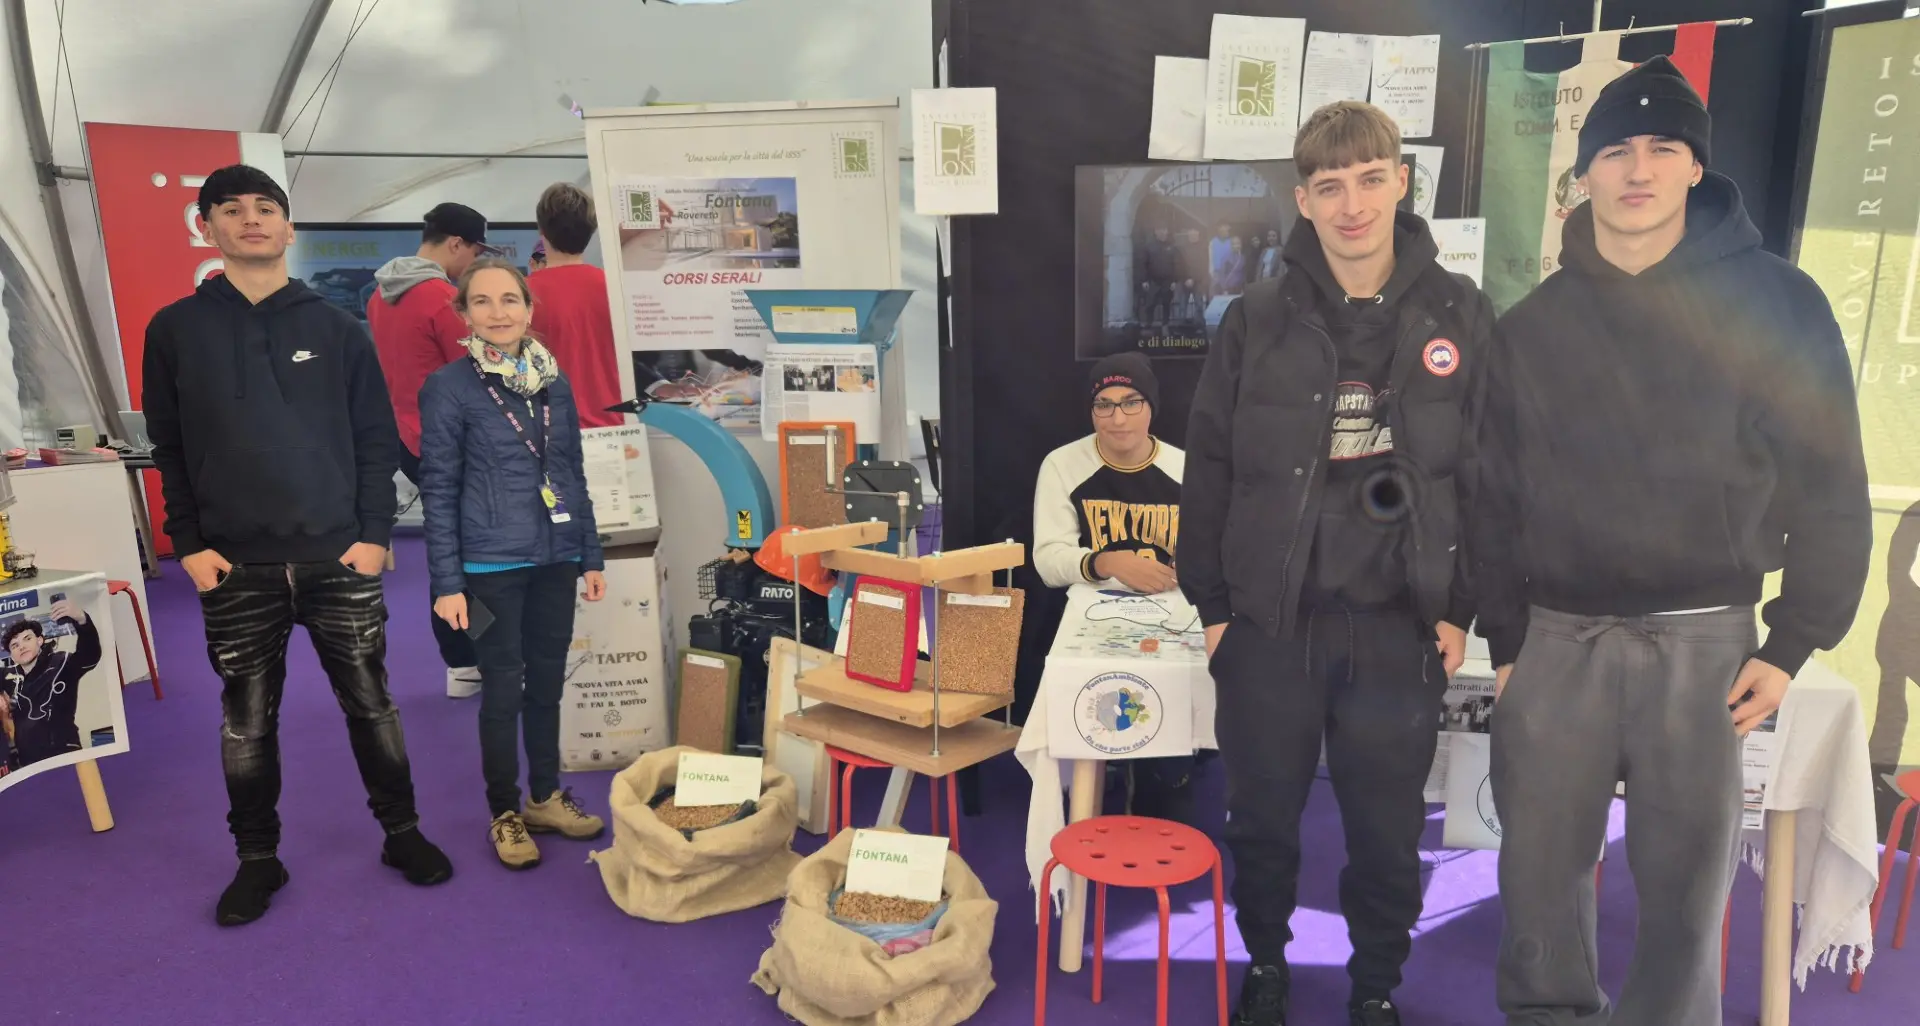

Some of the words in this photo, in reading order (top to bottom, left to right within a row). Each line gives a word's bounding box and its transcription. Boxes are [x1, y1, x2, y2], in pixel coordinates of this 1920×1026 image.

[705, 193, 773, 209] Fontana
[677, 209, 719, 220] Rovereto
[1443, 252, 1477, 261] TAPPO
[663, 273, 708, 285] CORSI
[711, 272, 762, 284] SERALI
[1147, 336, 1159, 348] di
[1162, 335, 1206, 349] dialogo
[1082, 498, 1128, 552] NEW
[760, 586, 794, 600] RATO
[595, 650, 648, 665] TAPPO
[604, 680, 623, 688] VITA
[620, 698, 647, 706] BOTTO
[682, 771, 730, 782] FONTANA
[855, 848, 909, 864] FONTANA
